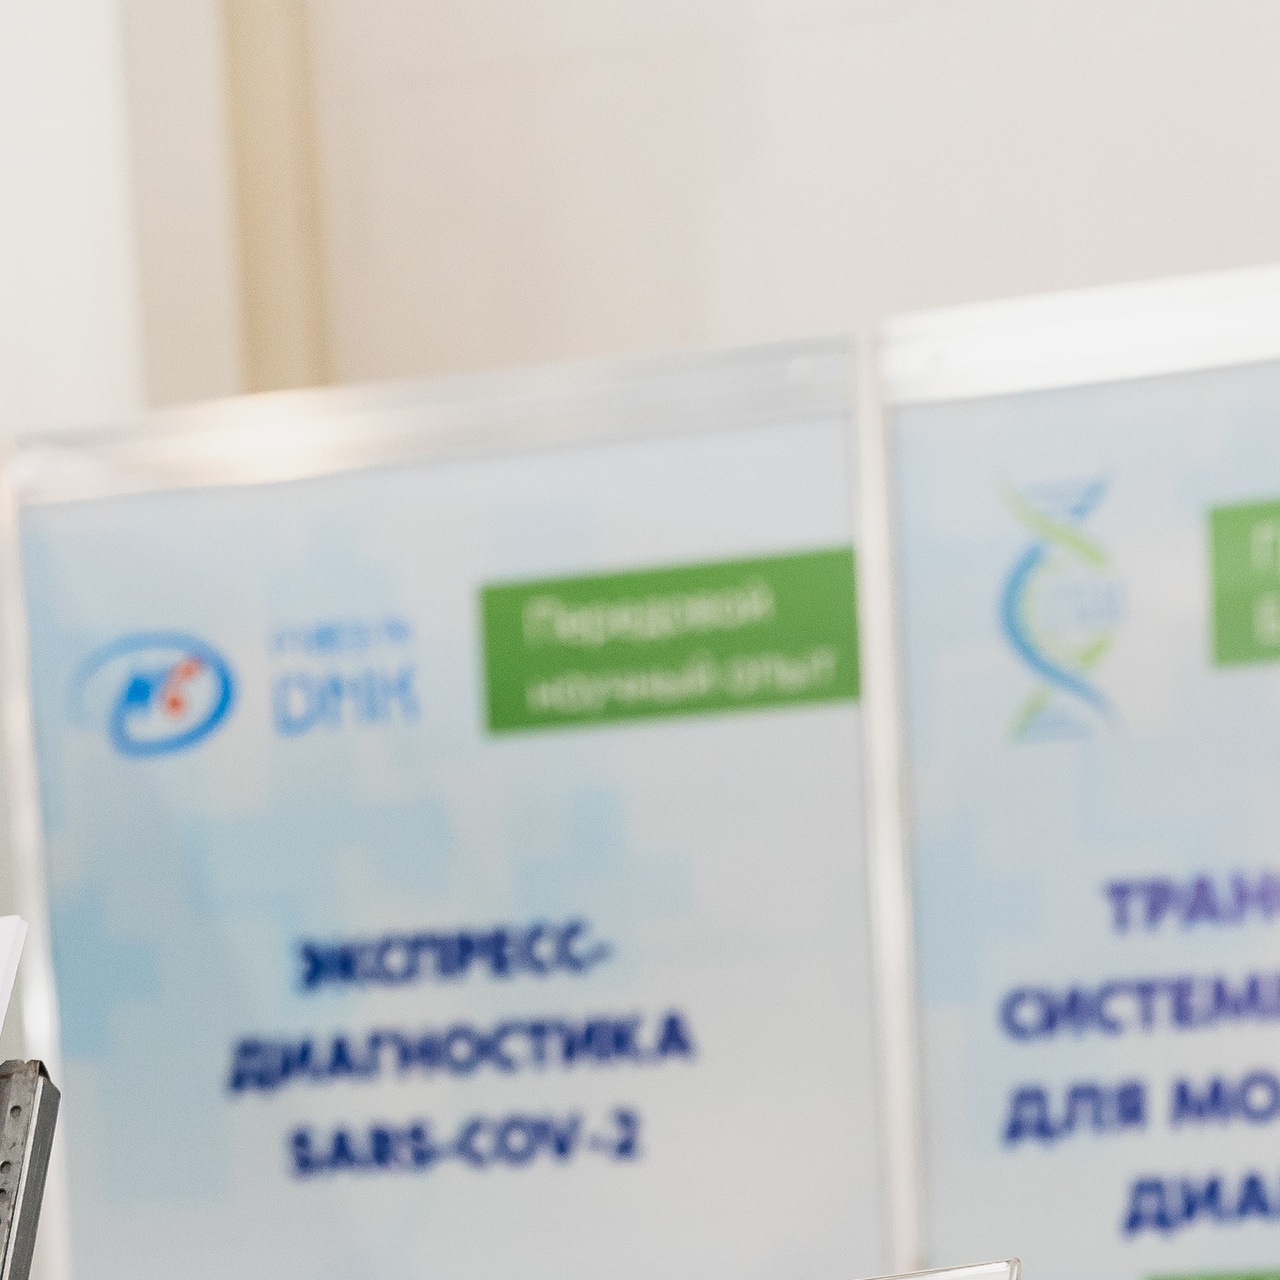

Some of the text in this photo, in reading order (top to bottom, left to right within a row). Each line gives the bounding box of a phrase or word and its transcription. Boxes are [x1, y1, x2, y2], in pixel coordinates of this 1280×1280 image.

[295, 916, 613, 993] ЭКСПРЕСС-
[229, 1008, 693, 1100] ДИАГНОСТИКА
[290, 1106, 640, 1177] SARS-COV-2
[1004, 1074, 1147, 1151] ДЛЯ
